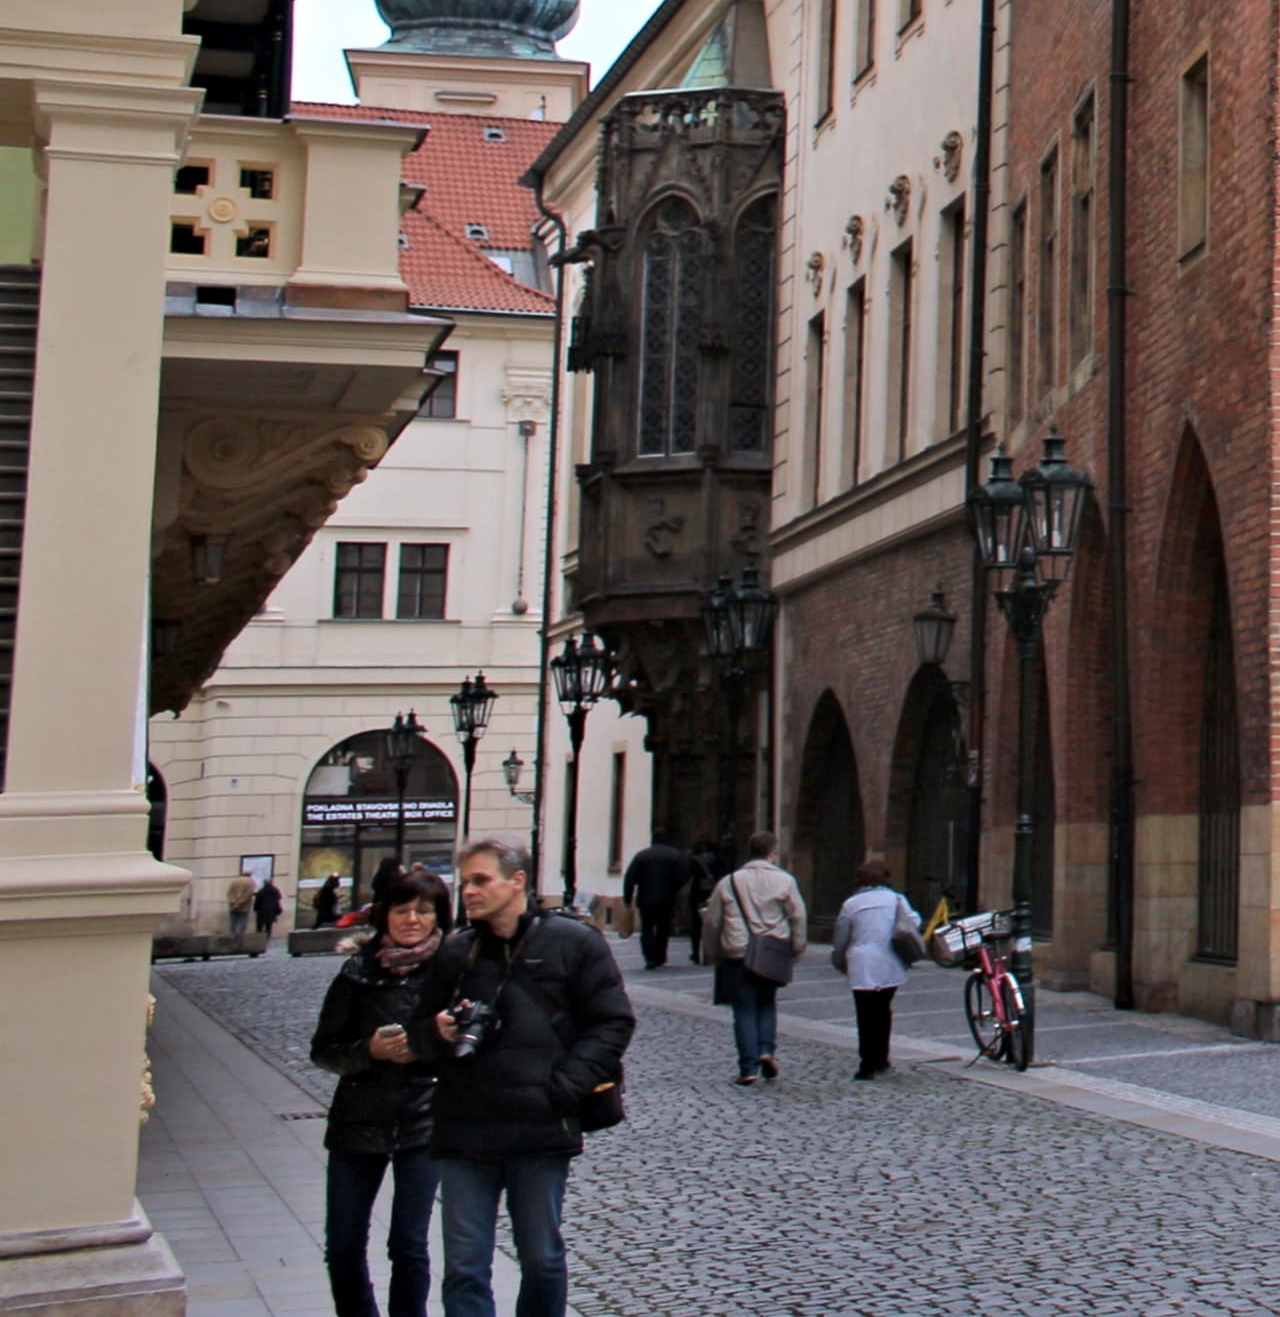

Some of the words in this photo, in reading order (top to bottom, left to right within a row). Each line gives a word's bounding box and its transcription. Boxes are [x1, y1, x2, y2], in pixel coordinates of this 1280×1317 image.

[306, 804, 354, 812] POKLADNA
[356, 803, 417, 811] STAVOVSKHO
[419, 801, 455, 810] DIVADLA
[306, 813, 324, 821] THE
[326, 812, 363, 820] ESTATES
[365, 811, 402, 820] THEATR
[403, 811, 422, 819] BOX
[424, 810, 455, 818] OFFICE
